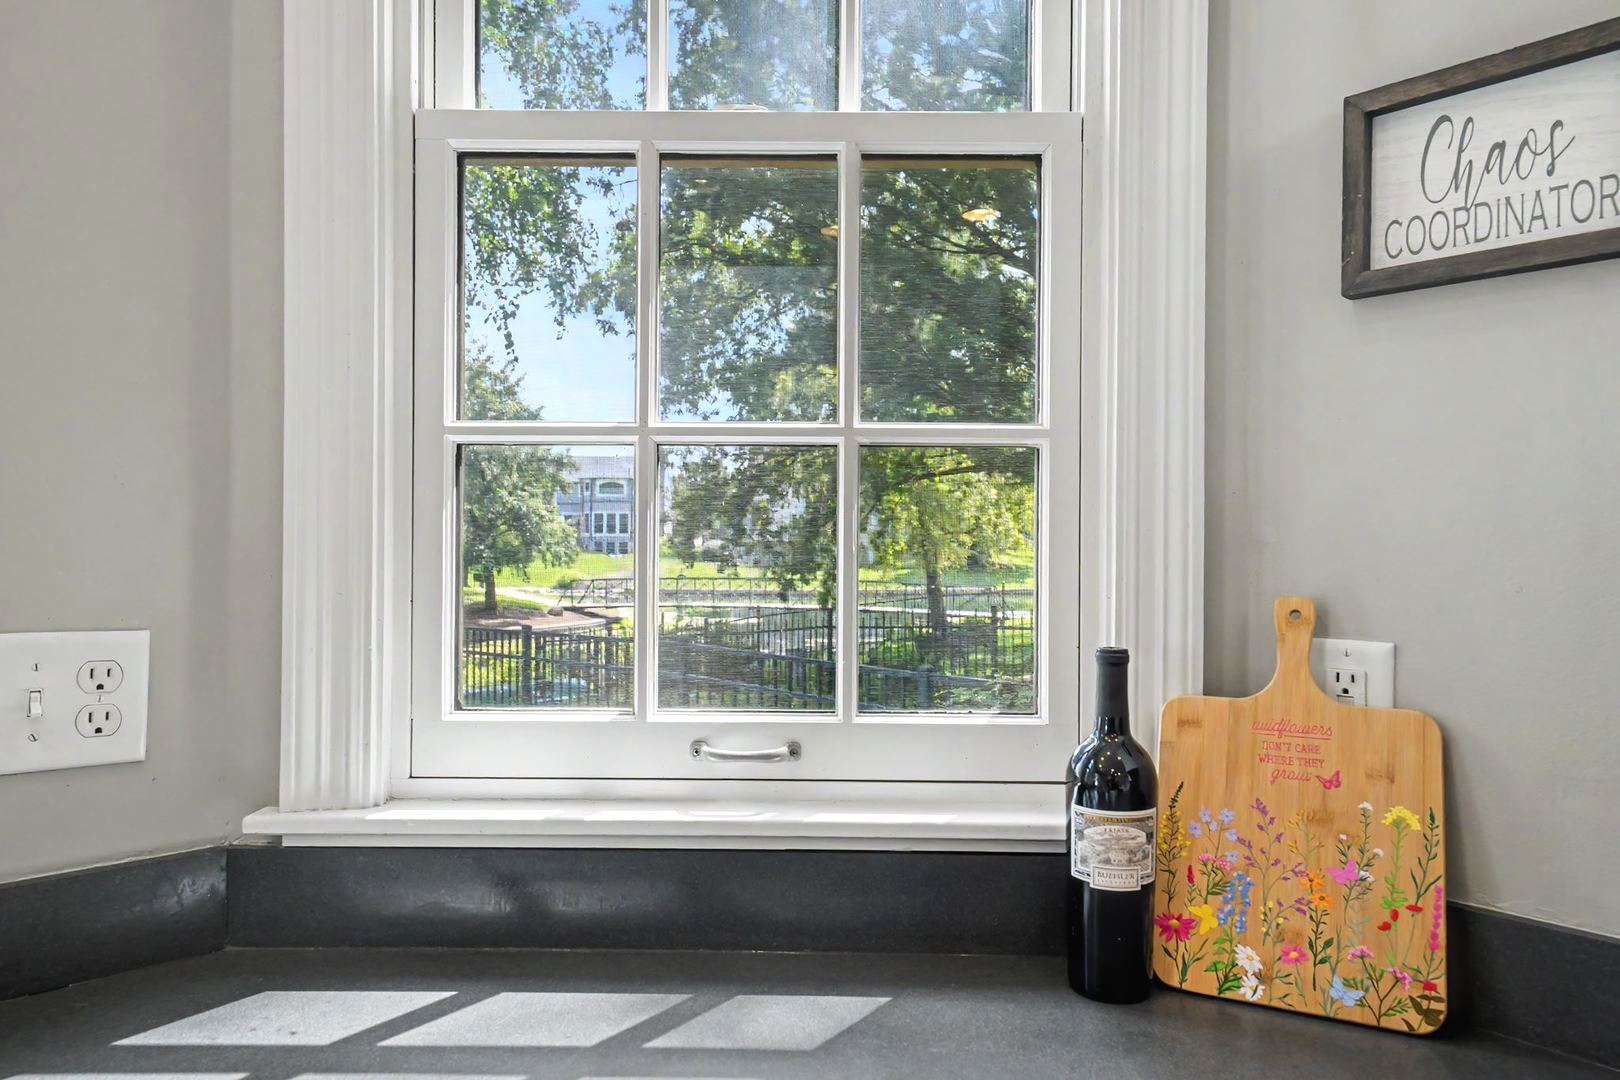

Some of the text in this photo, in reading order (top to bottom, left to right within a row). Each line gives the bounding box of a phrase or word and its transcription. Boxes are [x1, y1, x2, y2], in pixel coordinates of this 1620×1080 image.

[1421, 114, 1576, 211] Chaos
[1384, 174, 1620, 259] COORDINATOR
[1252, 718, 1333, 738] wildflowers
[1262, 740, 1321, 754] DON'T CARE
[1258, 753, 1325, 768] WHERE THEY
[1270, 768, 1311, 785] grow
